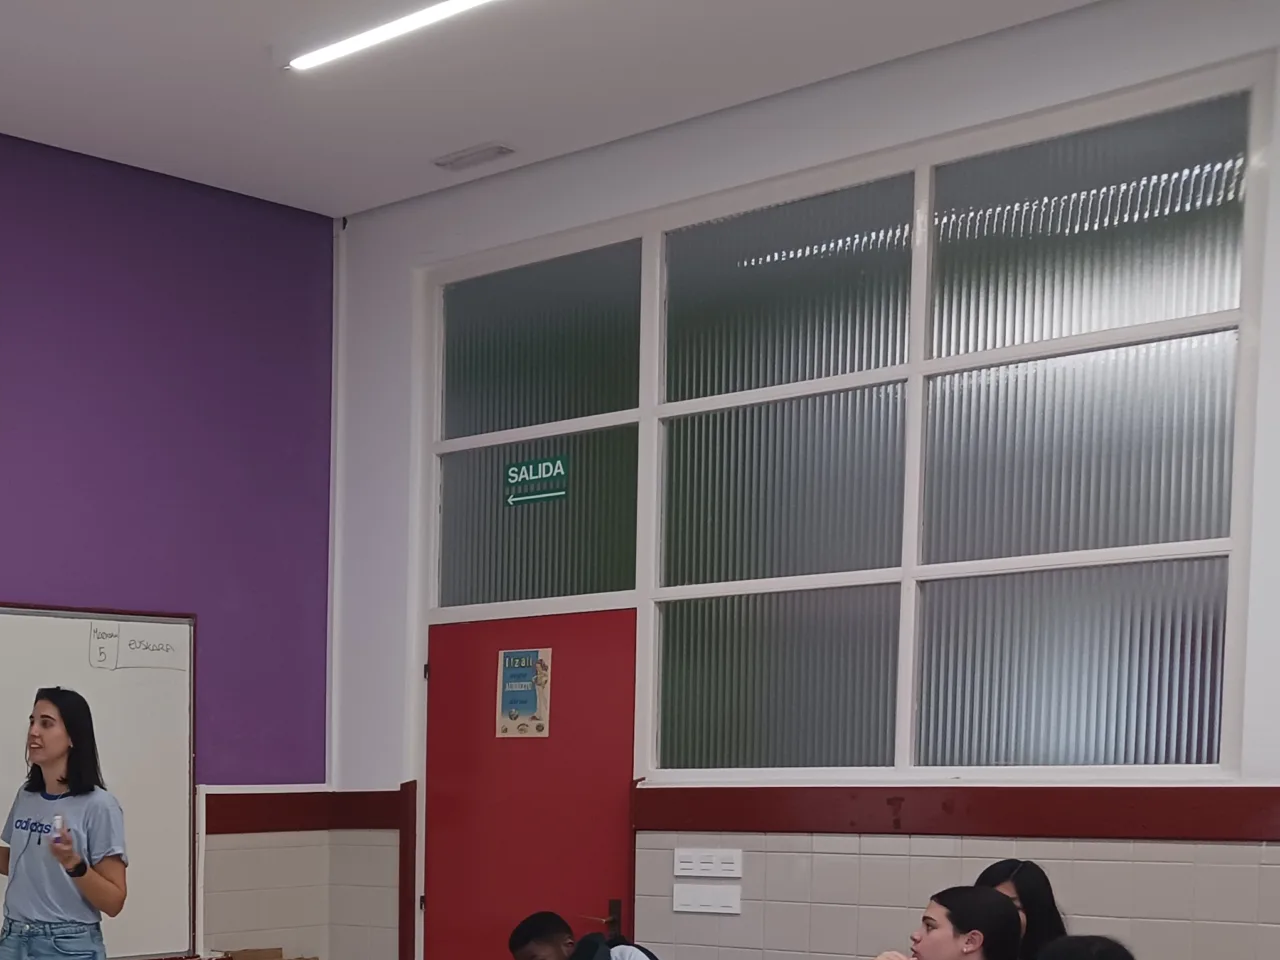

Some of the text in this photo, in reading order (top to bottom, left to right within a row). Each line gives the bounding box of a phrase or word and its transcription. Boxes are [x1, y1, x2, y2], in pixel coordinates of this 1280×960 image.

[508, 460, 565, 483] SALIDA
[97, 646, 107, 662] 5
[14, 818, 52, 834] adidas
